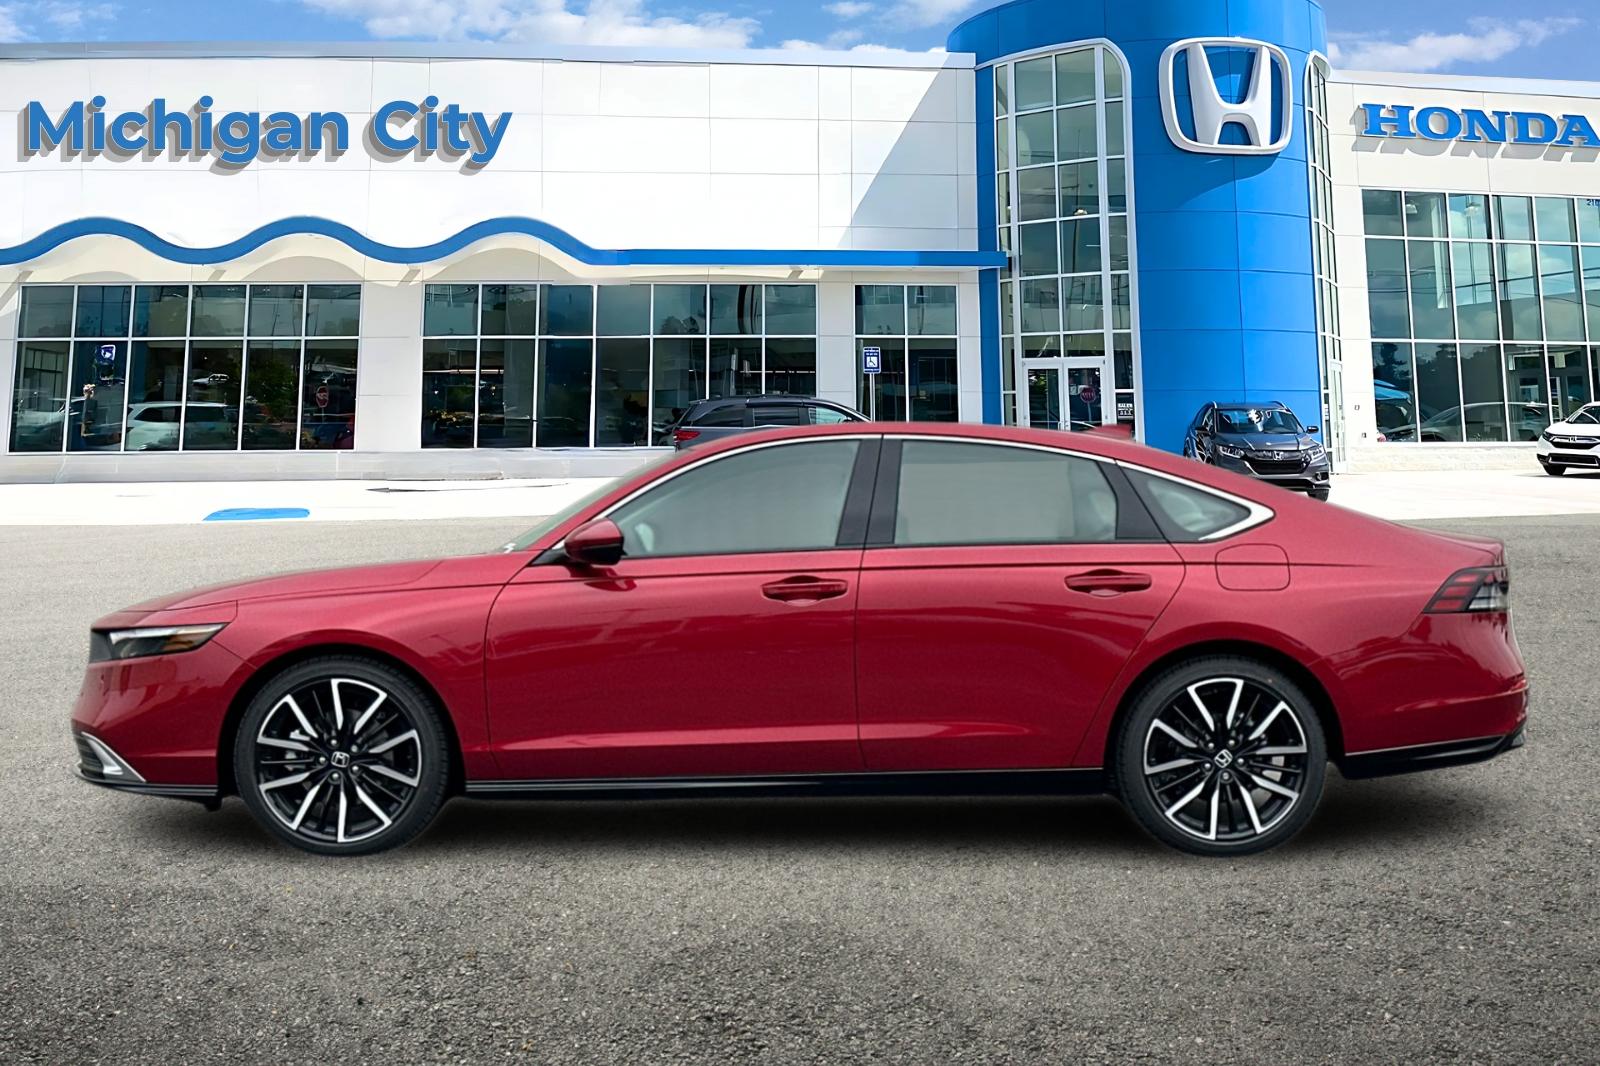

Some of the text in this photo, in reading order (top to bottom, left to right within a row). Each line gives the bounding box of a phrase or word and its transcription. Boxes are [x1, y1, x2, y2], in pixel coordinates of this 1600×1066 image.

[28, 95, 513, 164] Michigan City
[1361, 103, 1600, 147] HONDA
